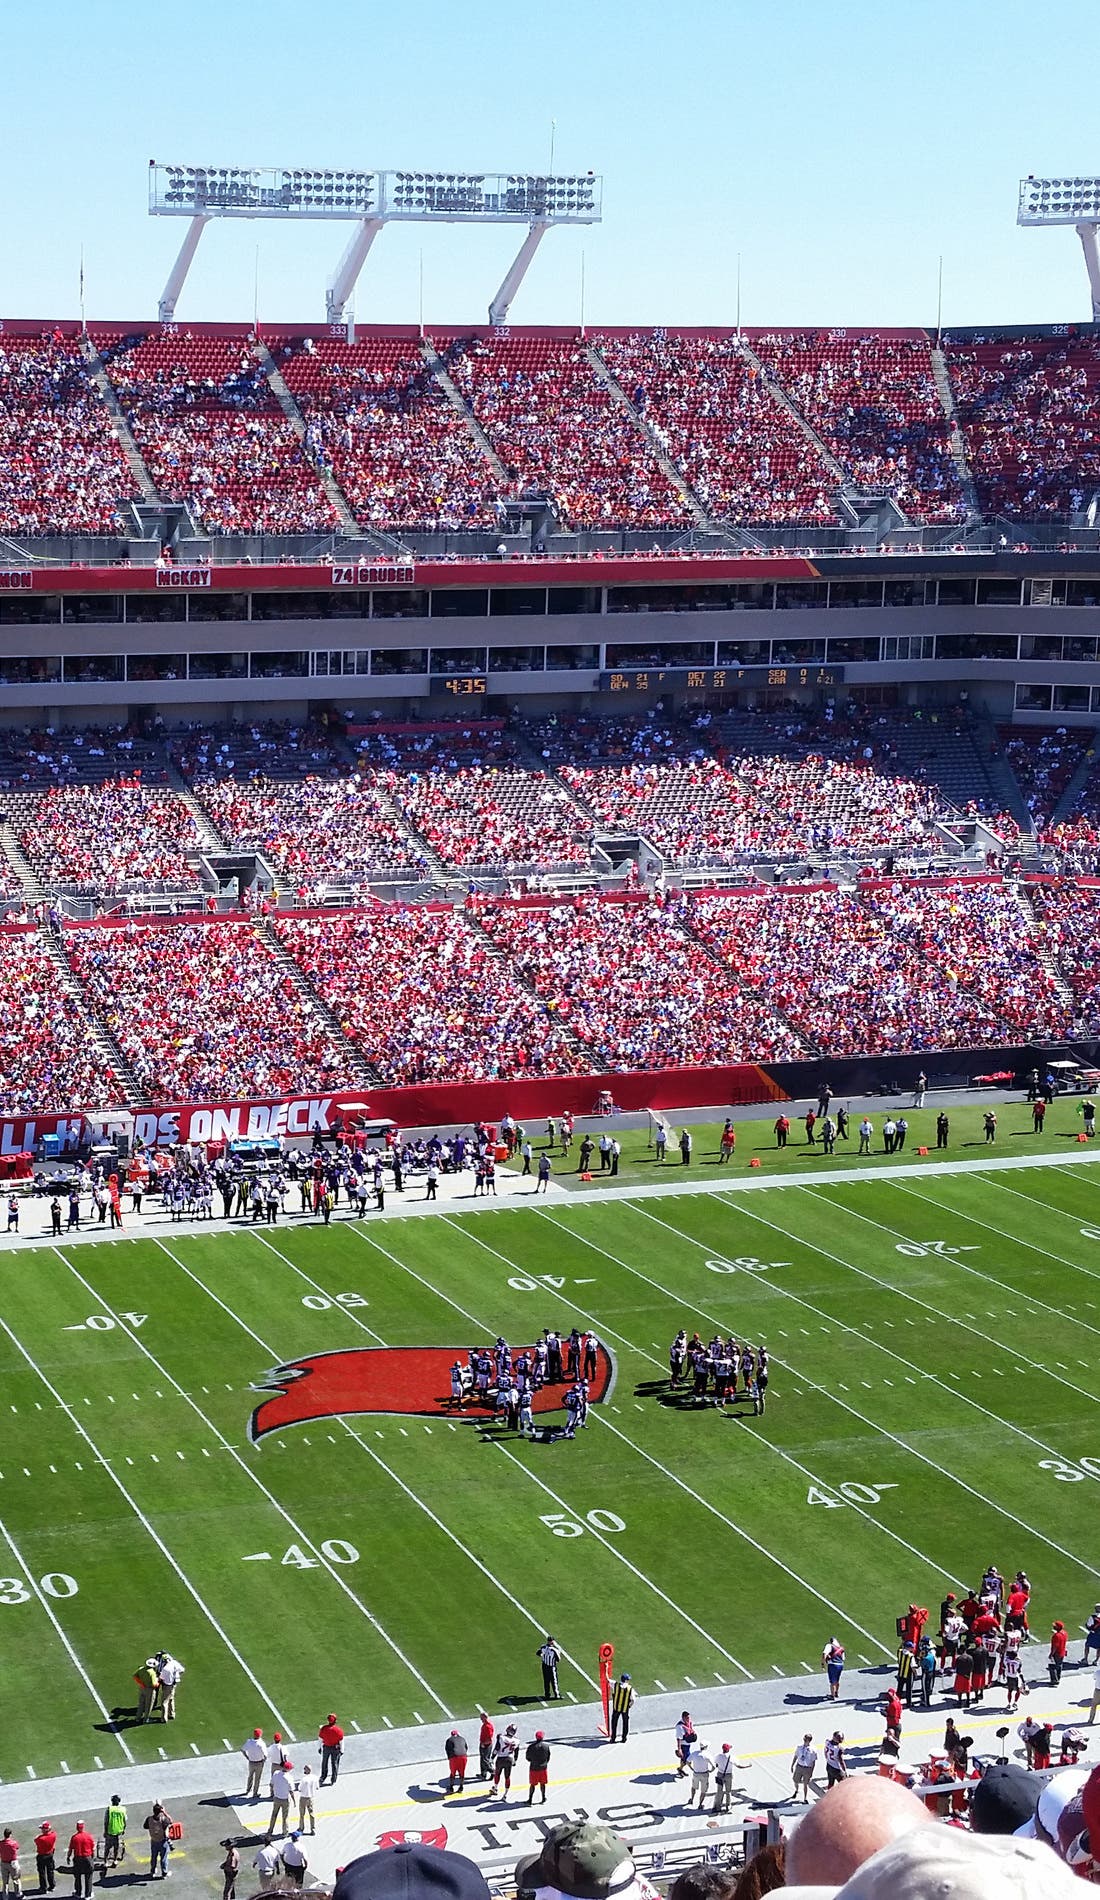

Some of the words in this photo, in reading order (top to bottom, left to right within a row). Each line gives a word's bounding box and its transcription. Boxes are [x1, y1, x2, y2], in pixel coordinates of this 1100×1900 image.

[330, 325, 347, 335] 333
[494, 327, 510, 336] 332
[334, 568, 353, 584] 74
[360, 567, 414, 582] GRUBER
[713, 671, 726, 679] 22
[446, 679, 487, 693] 4:35
[188, 1107, 242, 1143] ON
[247, 1099, 333, 1136] DECK
[704, 1257, 769, 1274] 30
[507, 1274, 566, 1291] 40
[301, 1292, 369, 1311] 50
[86, 1311, 148, 1331] 40
[807, 1482, 881, 1509] 40
[538, 1509, 627, 1537] 50
[280, 1539, 360, 1569] 40
[0, 1573, 79, 1604] 30
